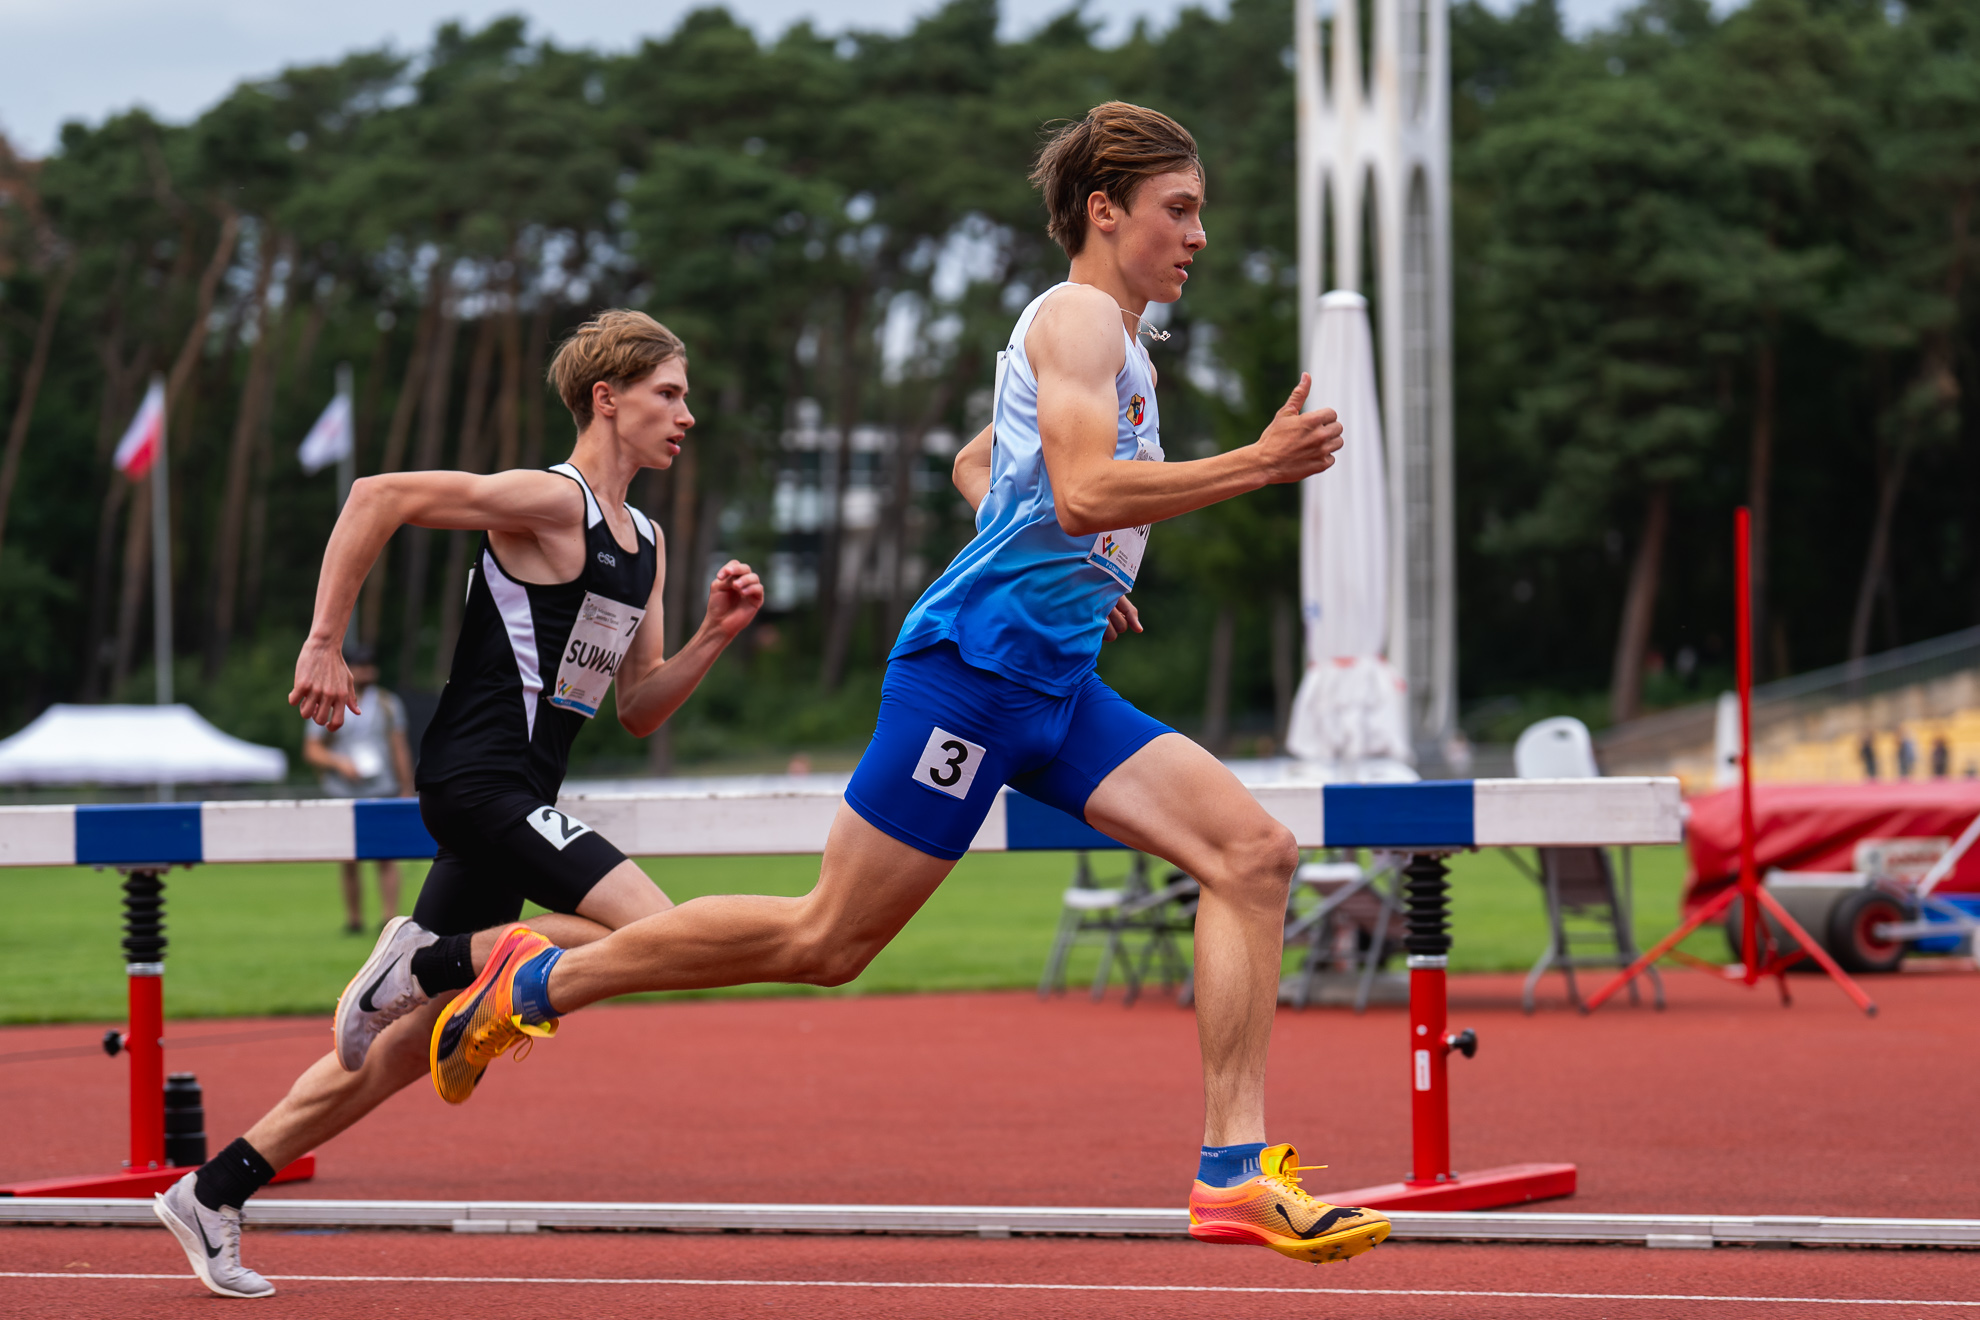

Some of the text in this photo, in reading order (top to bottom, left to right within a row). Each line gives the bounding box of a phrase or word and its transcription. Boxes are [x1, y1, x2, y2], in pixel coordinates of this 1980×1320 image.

[597, 552, 615, 567] esa
[930, 740, 968, 787] 3
[542, 808, 584, 840] 2
